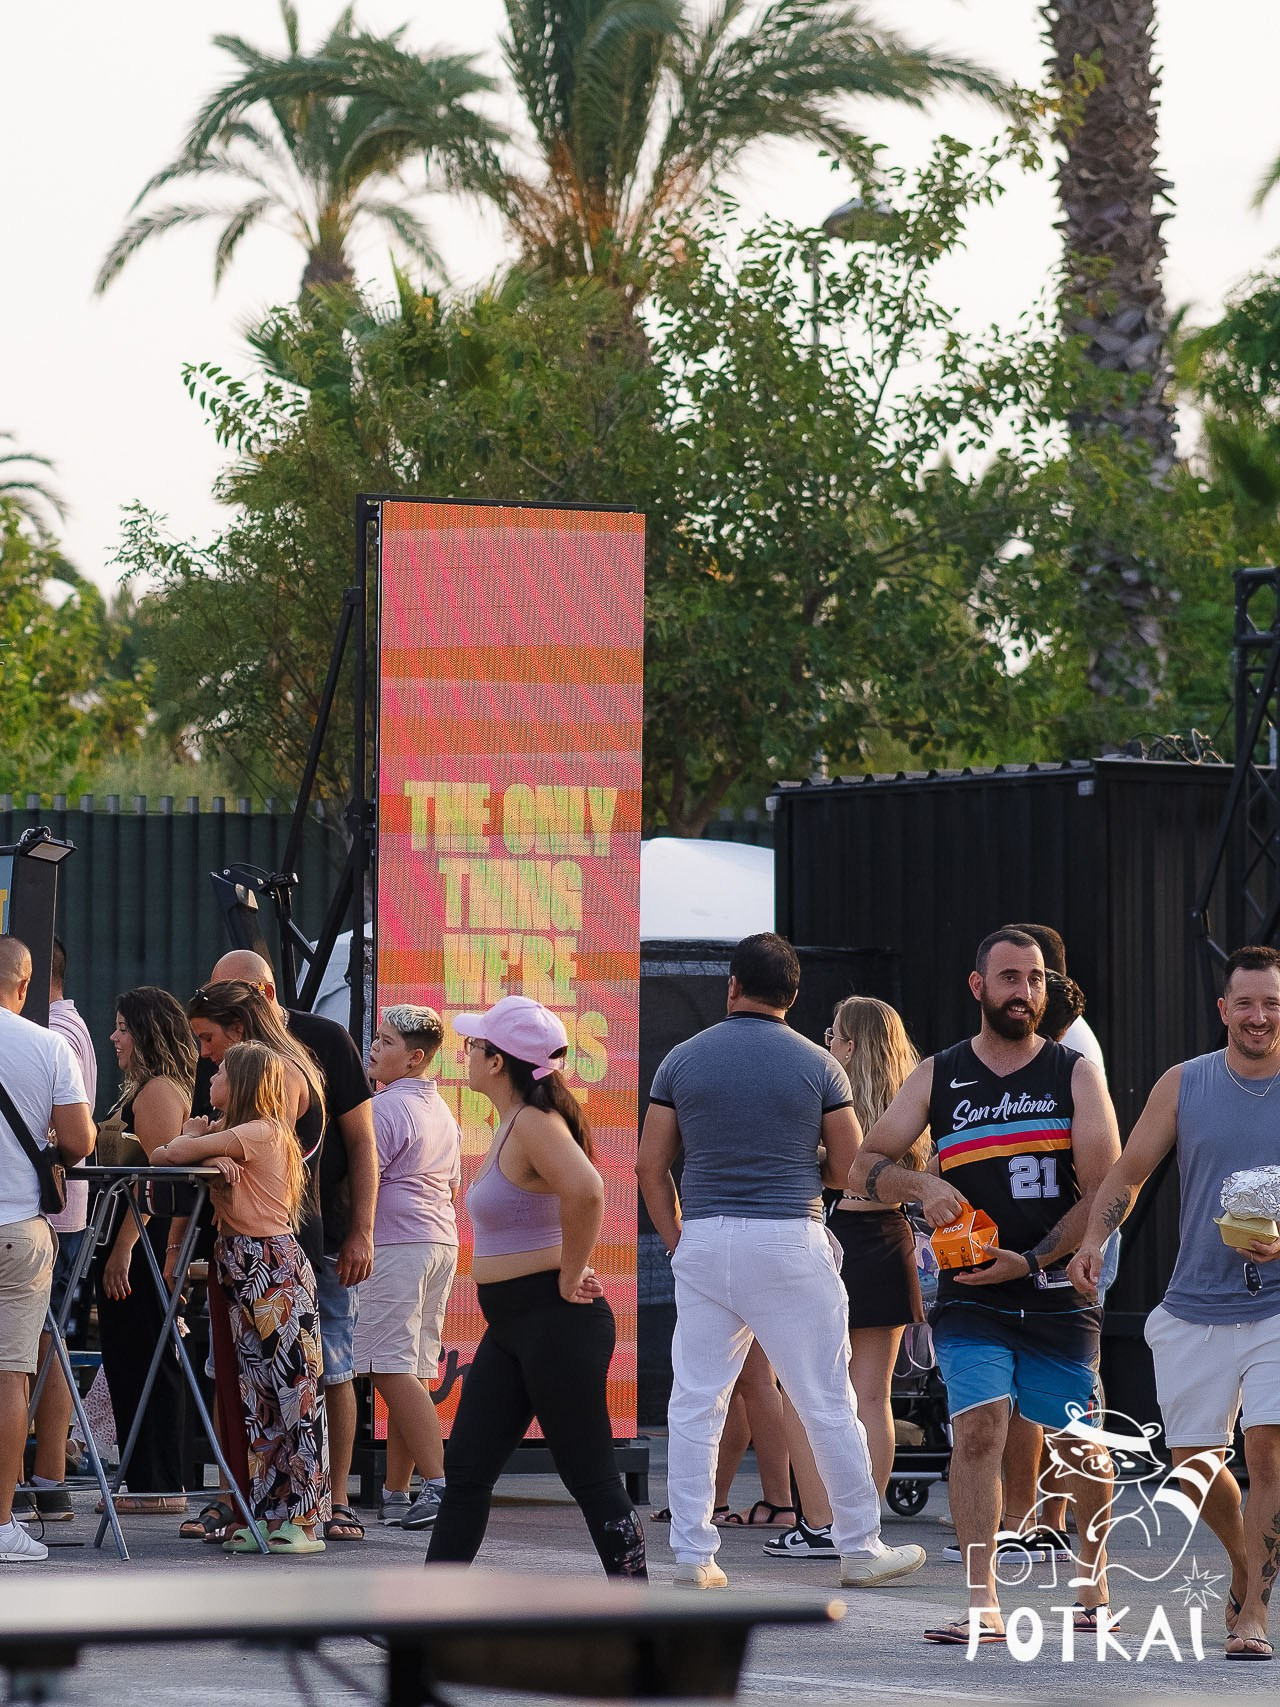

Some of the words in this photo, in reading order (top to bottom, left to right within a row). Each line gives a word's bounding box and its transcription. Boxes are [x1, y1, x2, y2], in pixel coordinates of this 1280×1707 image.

[405, 780, 491, 852] THE
[503, 783, 618, 857] ONLY
[952, 1100, 992, 1131] San
[991, 1092, 1058, 1121] Antonio
[1008, 1155, 1060, 1200] 21
[942, 1223, 964, 1235] RICO
